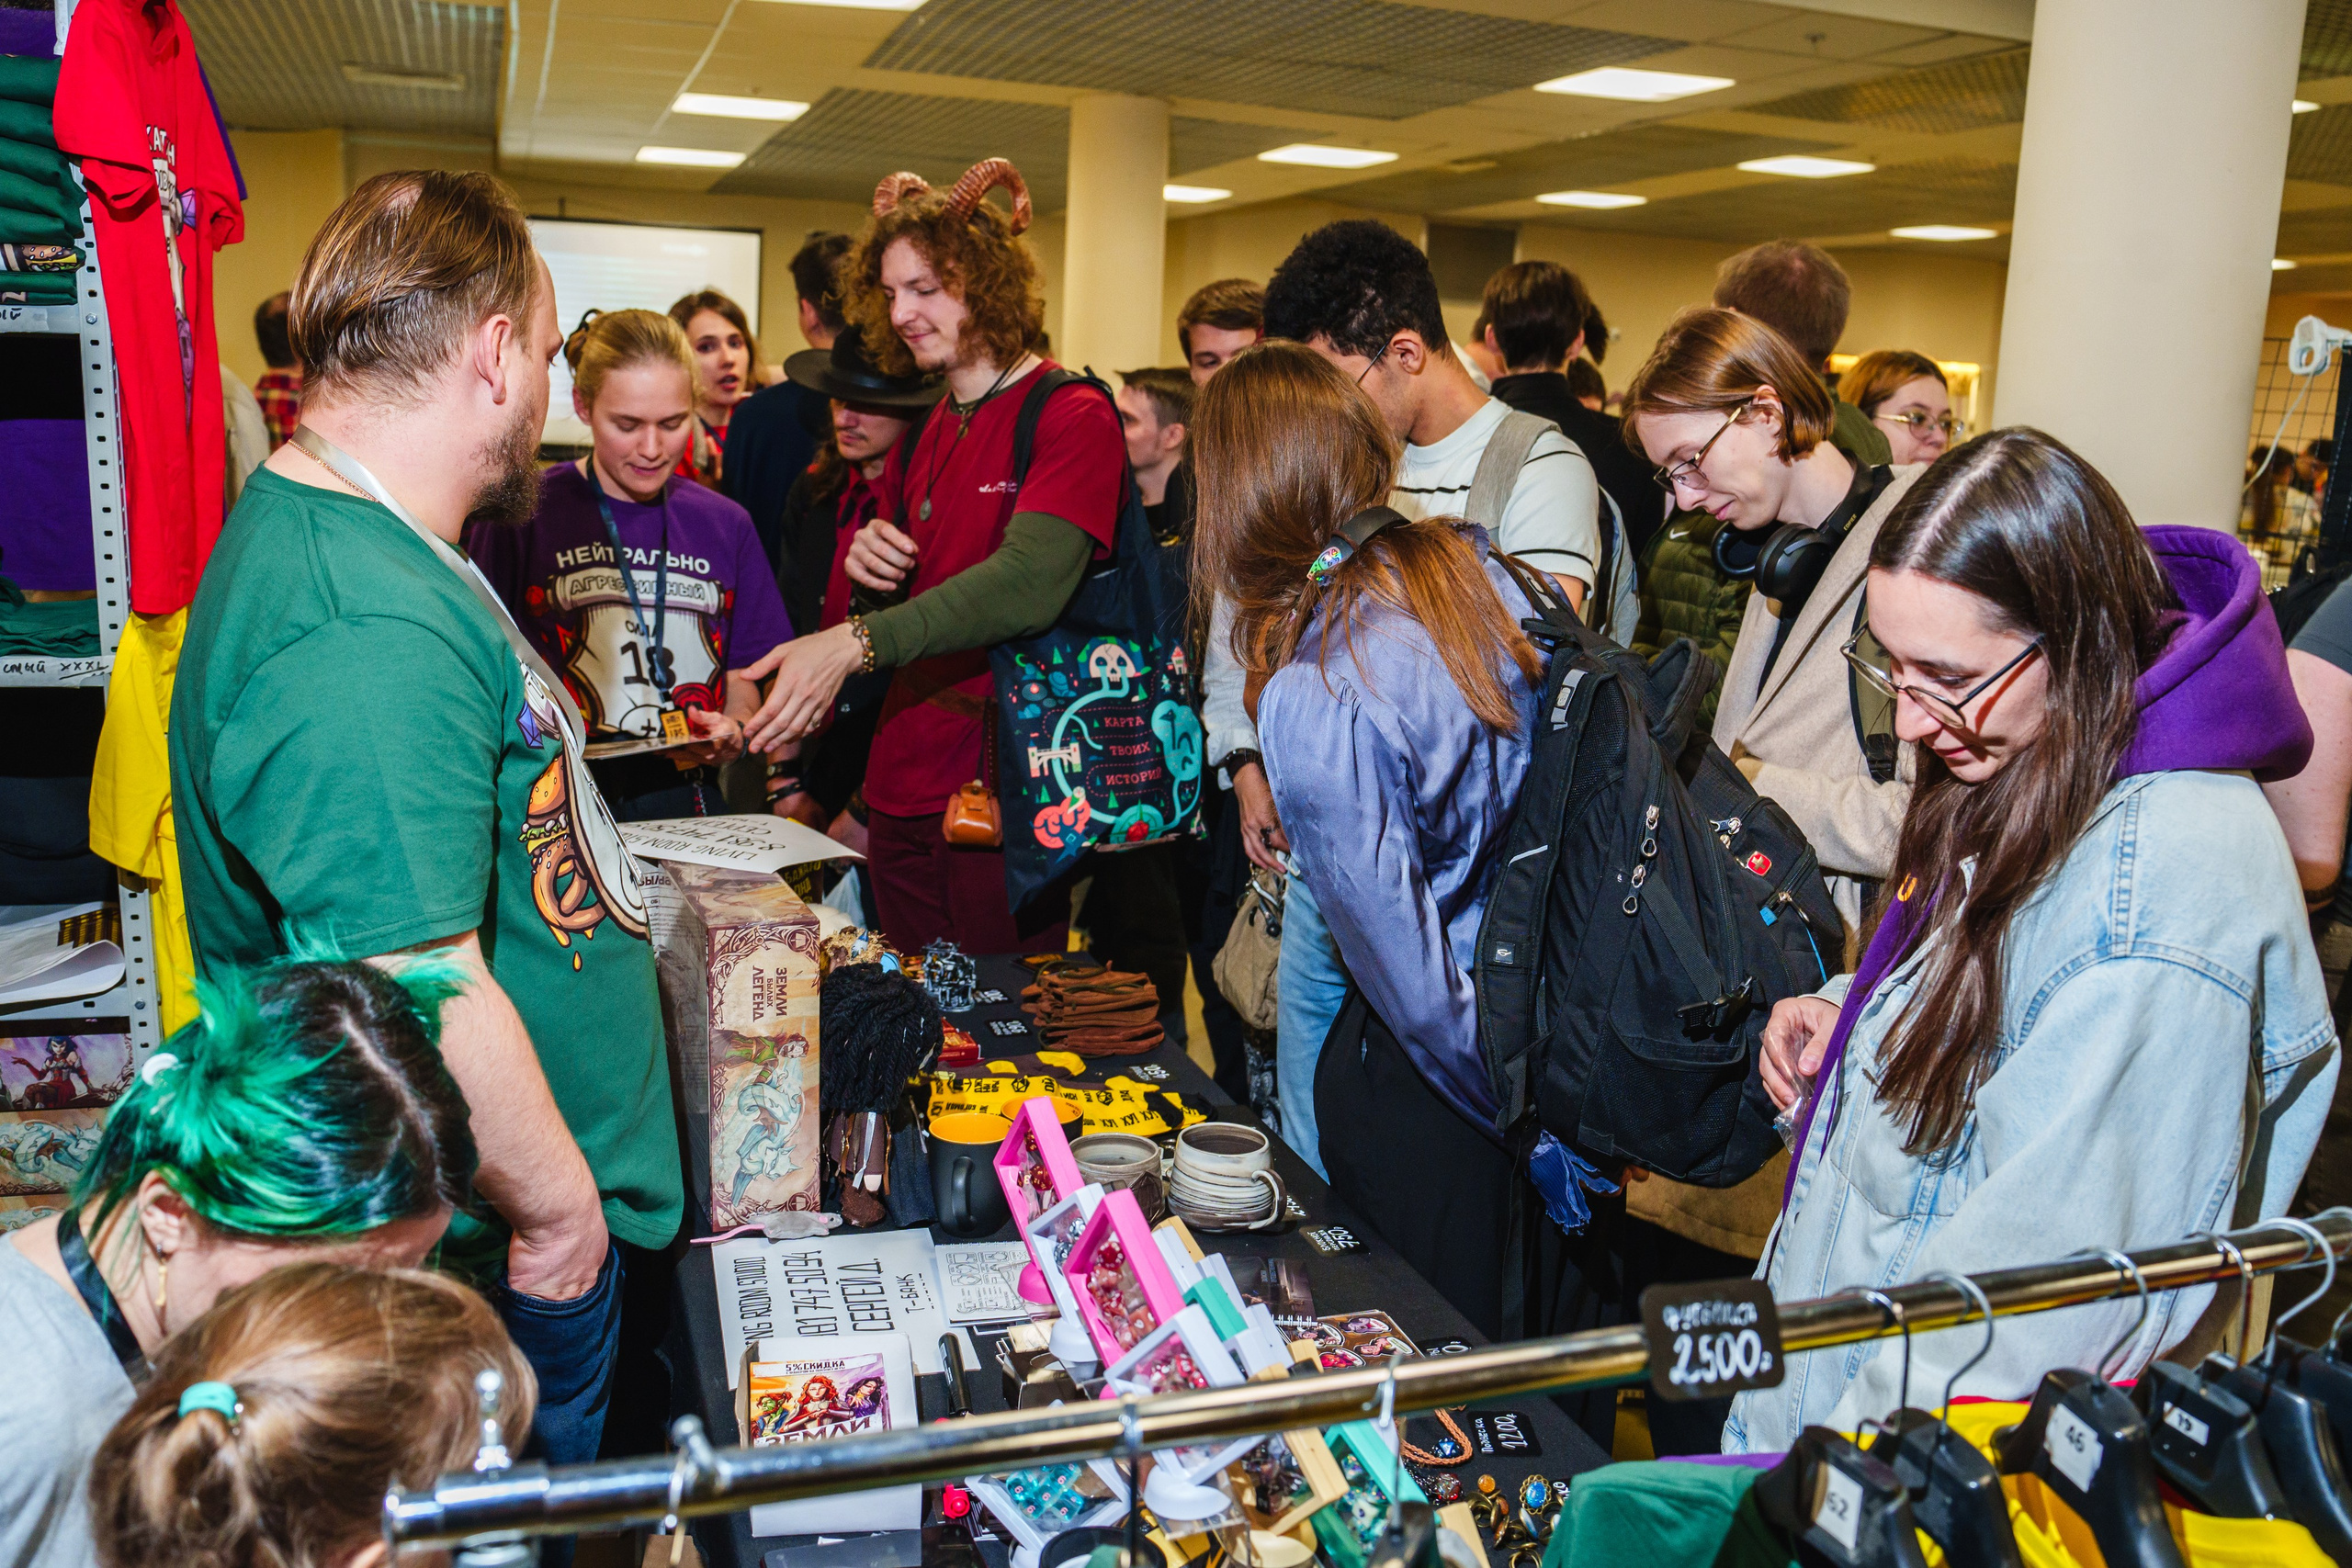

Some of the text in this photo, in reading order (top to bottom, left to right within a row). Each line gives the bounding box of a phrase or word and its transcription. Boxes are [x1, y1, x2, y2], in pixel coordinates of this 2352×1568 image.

[620, 640, 677, 691] 18
[1104, 716, 1145, 728] КАРТА
[1109, 741, 1151, 756] ТВОИХ
[1105, 766, 1162, 785] ИСТОРИЙ
[641, 837, 692, 852] ROOM
[691, 844, 758, 861] LIVING
[752, 964, 764, 1022] ЛЕГЕНД
[775, 967, 787, 1016] ЗЕМЛИ
[733, 1256, 769, 1286] STUDIO
[738, 1287, 773, 1320] ROOM
[789, 1288, 834, 1314] 747
[835, 1276, 896, 1332] СЕРГЕЙ
[786, 1363, 803, 1371] 5%
[803, 1360, 845, 1371] СКИДКА
